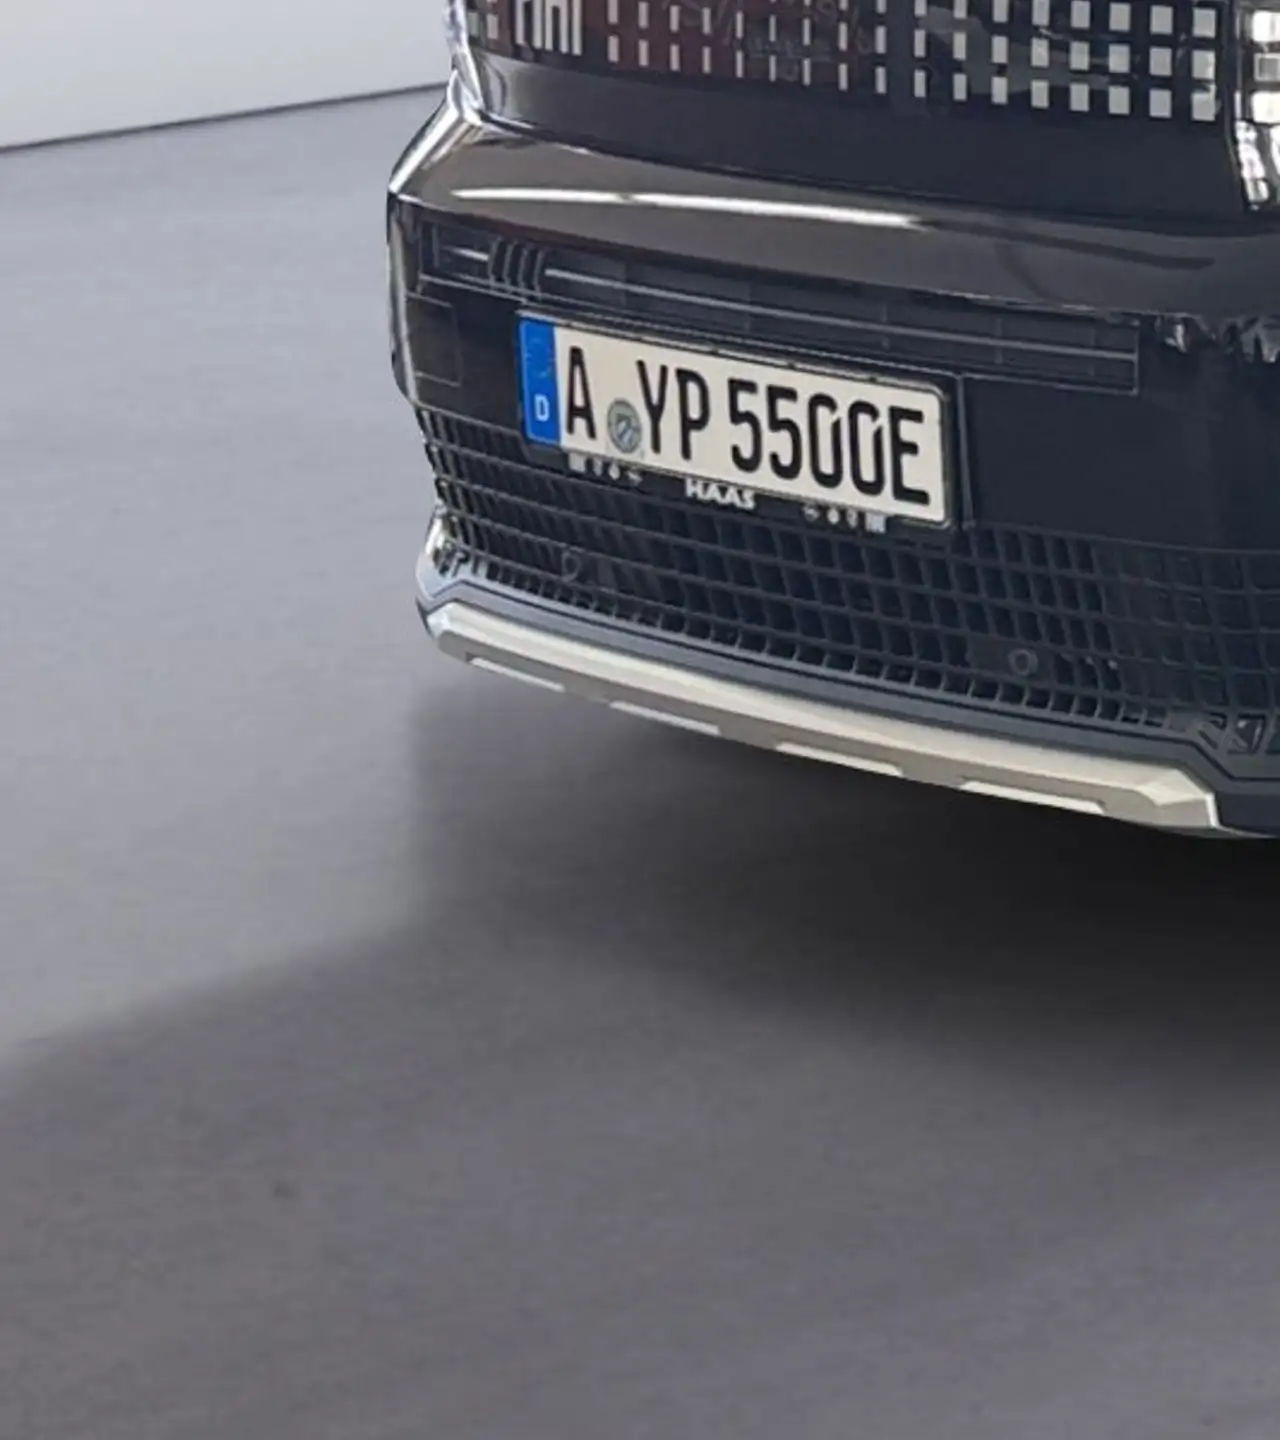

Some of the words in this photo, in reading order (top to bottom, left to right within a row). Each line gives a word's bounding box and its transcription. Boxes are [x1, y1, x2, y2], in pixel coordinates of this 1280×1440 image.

[535, 394, 550, 422] D
[565, 346, 597, 440] A
[636, 358, 711, 461] YP
[727, 376, 931, 506] 5500E
[685, 477, 757, 510] HAAS
